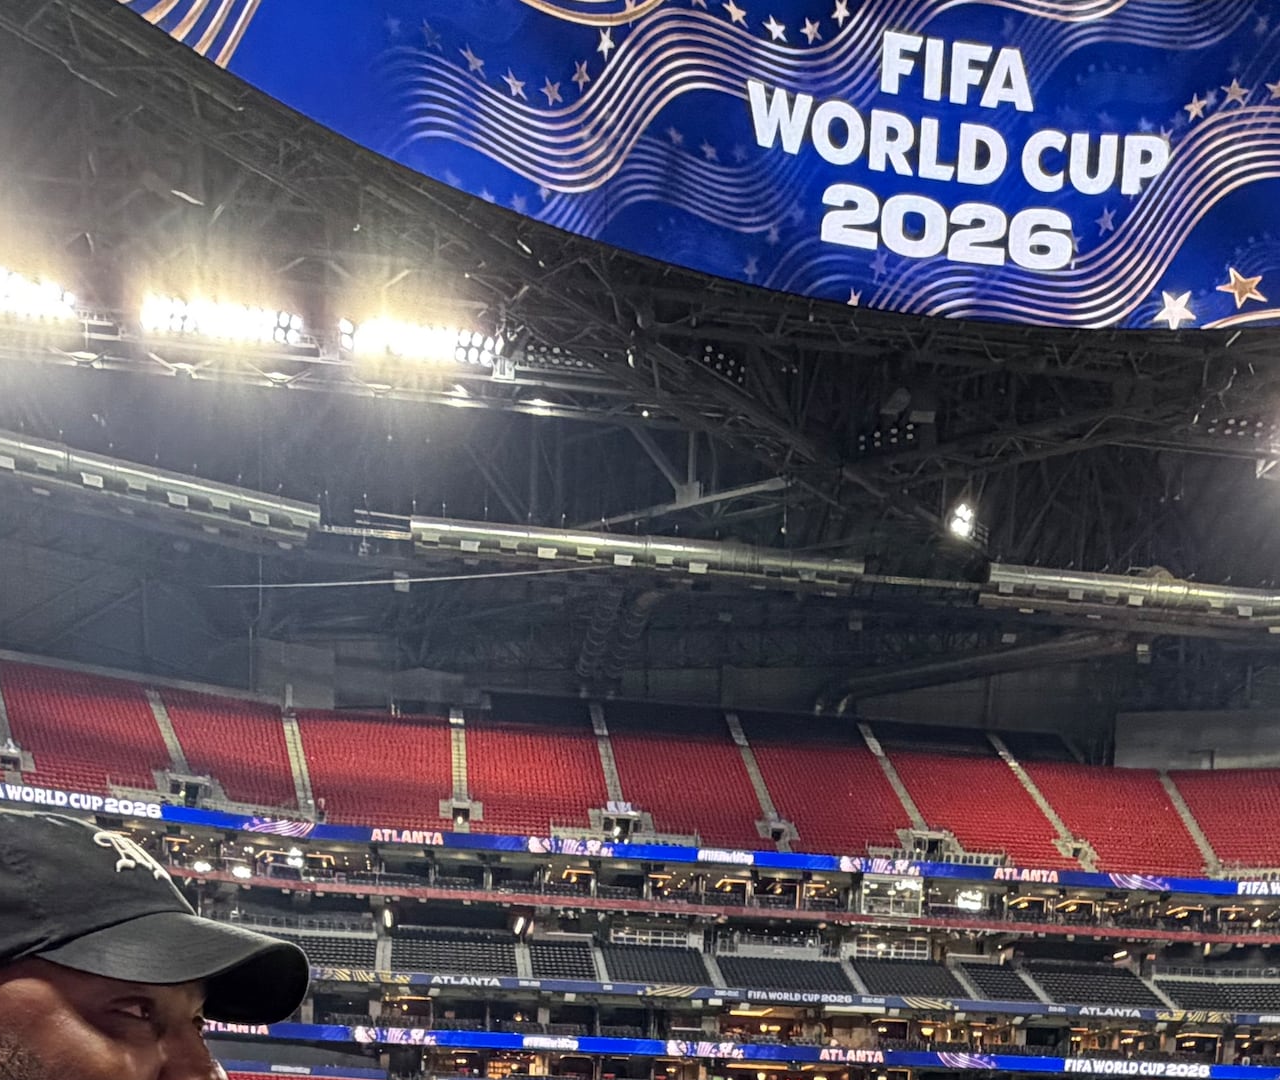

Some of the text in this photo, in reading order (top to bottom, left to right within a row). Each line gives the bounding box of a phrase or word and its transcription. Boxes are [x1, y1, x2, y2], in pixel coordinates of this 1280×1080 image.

[880, 30, 1034, 112] FIFA
[746, 80, 1170, 196] WORLD CUP
[820, 183, 1075, 270] 2026
[6, 784, 69, 807] WORLD
[69, 792, 104, 813] CUP
[104, 798, 162, 819] 2026
[370, 828, 445, 846] ATLANTA
[993, 868, 1059, 884] ATLANTA
[1236, 881, 1268, 895] FIFA
[430, 975, 502, 988] ATLANTA
[747, 990, 767, 1000] FIFA
[768, 991, 801, 1002] WORLD
[802, 993, 820, 1002] CUP
[820, 994, 853, 1004] 2026
[1078, 1006, 1142, 1018] ATLANTA
[819, 1048, 885, 1064] ATLANTA
[1064, 1058, 1211, 1078] FIFA WORLD CUP 2026
